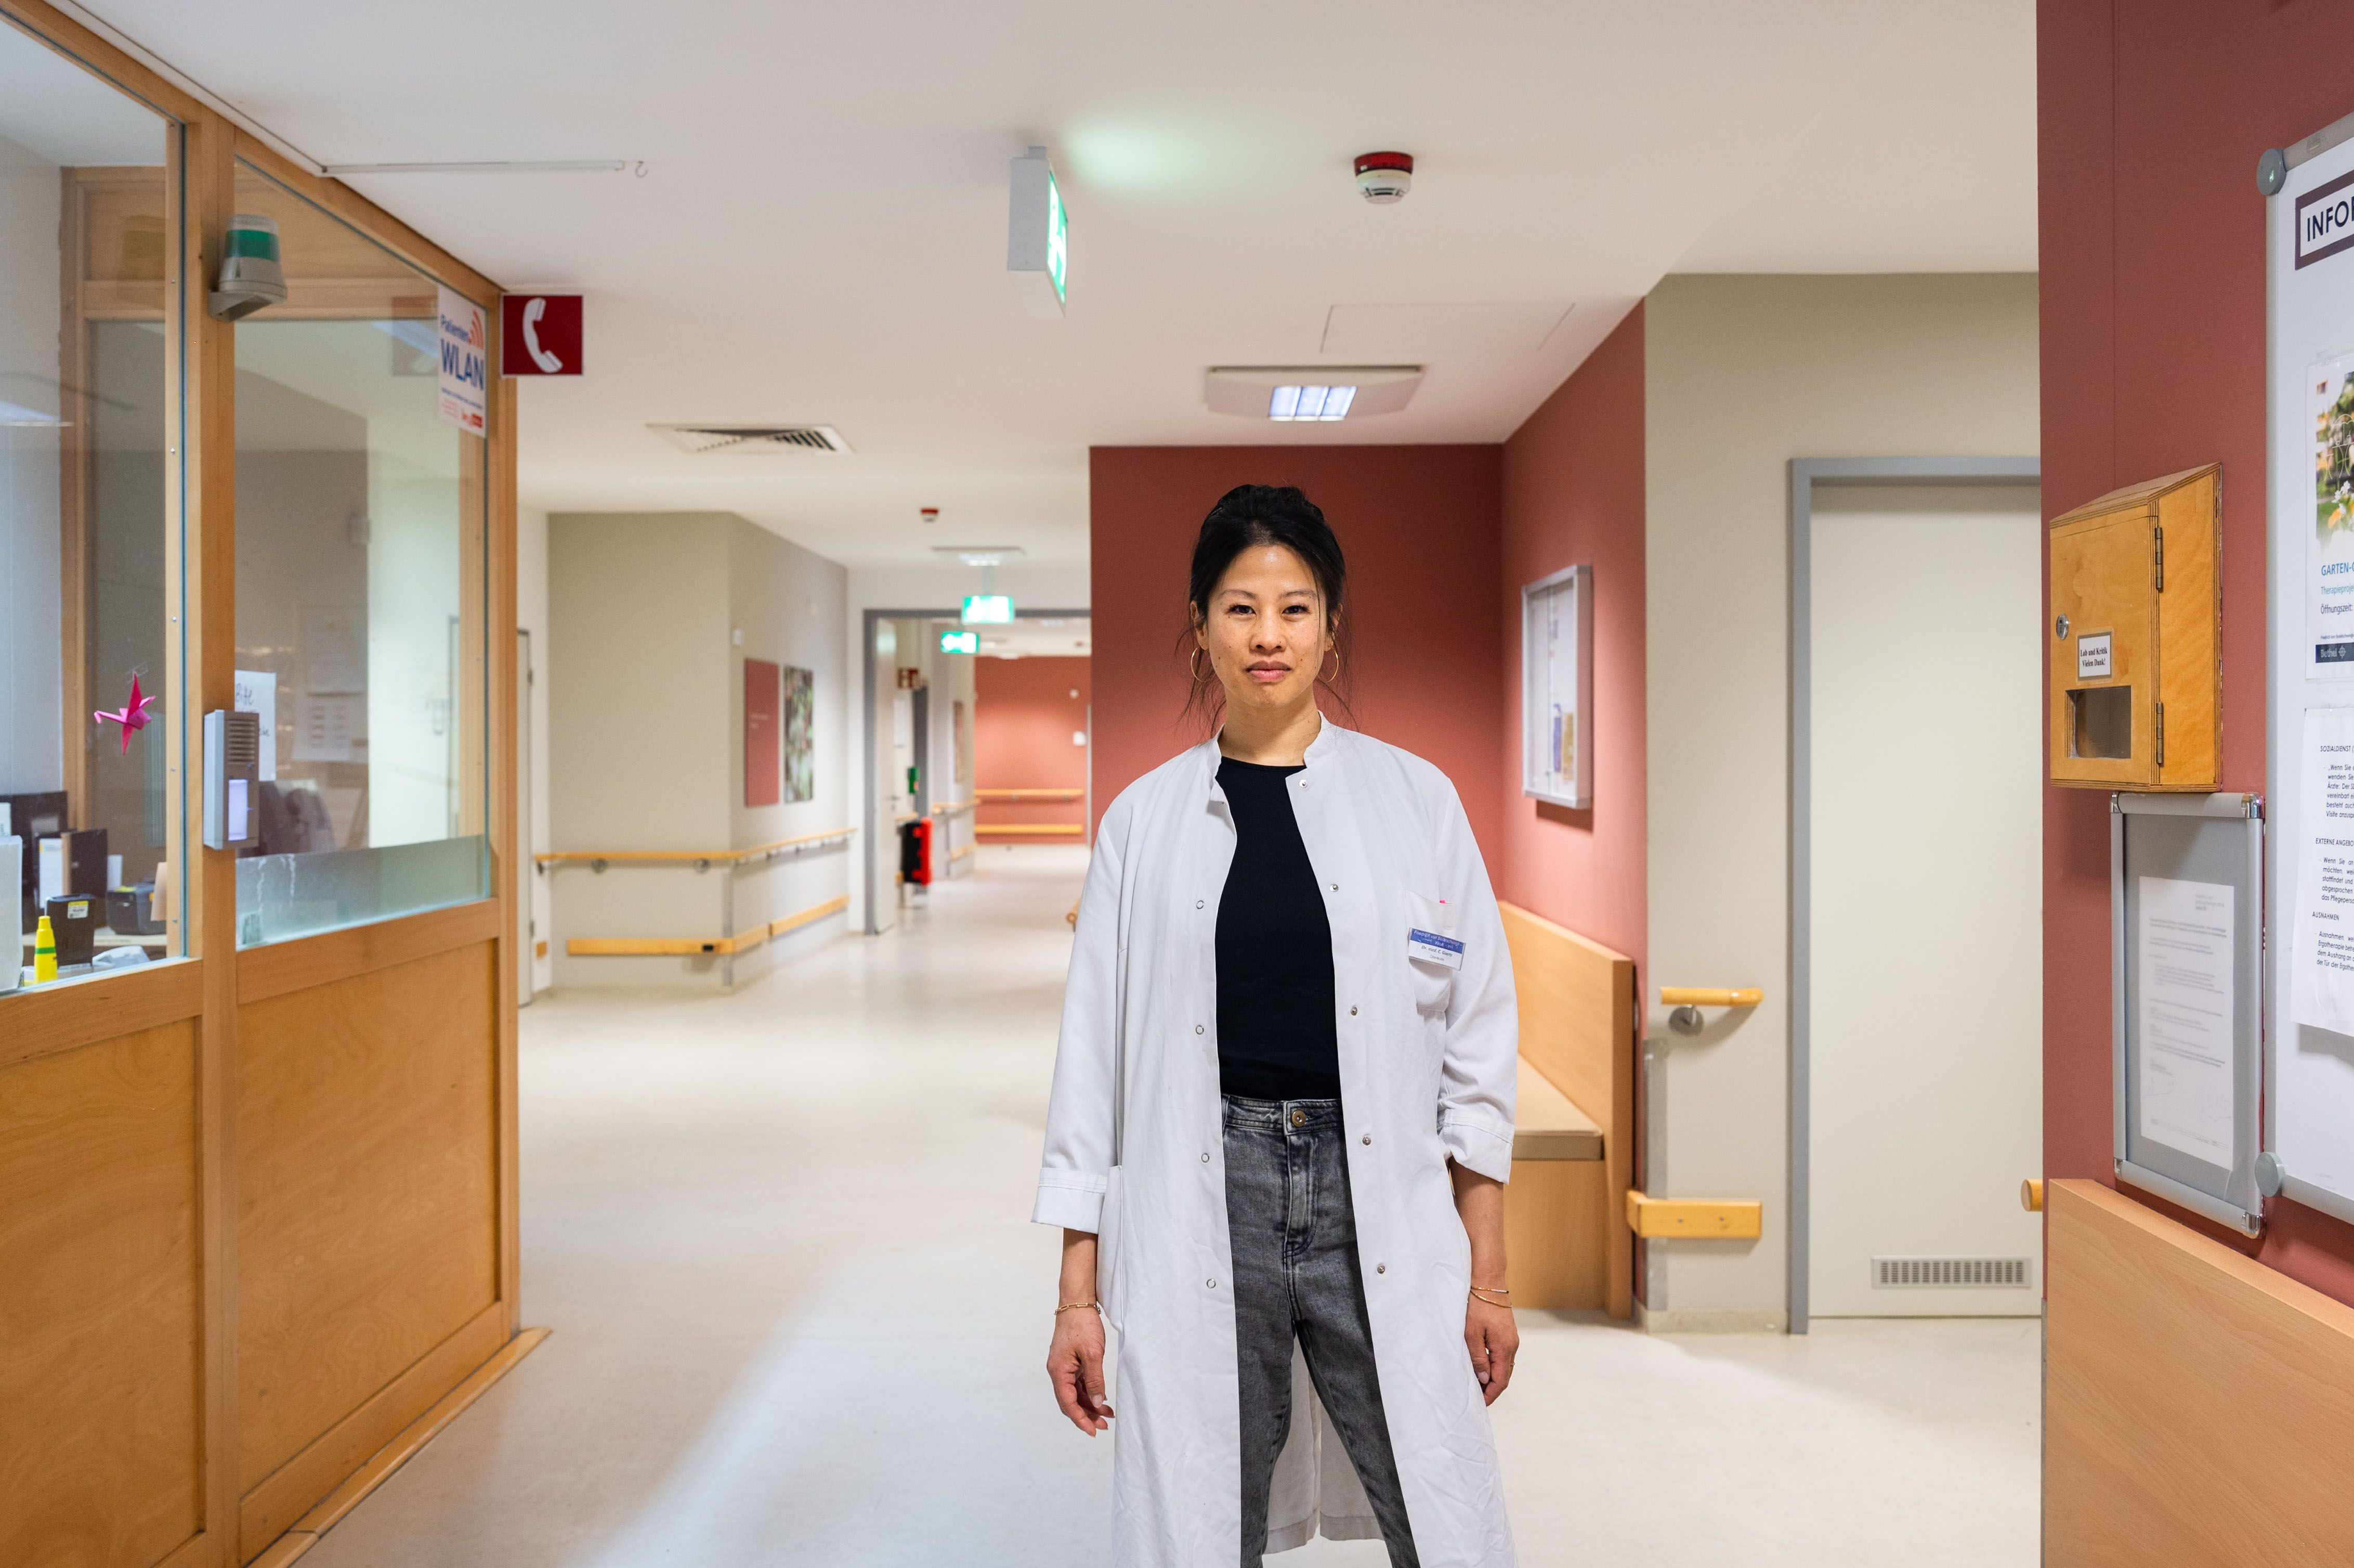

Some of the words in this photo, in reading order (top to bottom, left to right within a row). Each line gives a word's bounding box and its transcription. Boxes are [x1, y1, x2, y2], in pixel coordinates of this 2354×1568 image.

[441, 338, 483, 390] WLAN
[2320, 583, 2354, 595] Therapieproje
[2320, 603, 2353, 615] Öffnungszeit:
[2096, 647, 2108, 655] Kritik
[2320, 648, 2337, 658] Bethel
[2094, 658, 2105, 666] Dank!
[2322, 885, 2352, 894] abgesprochen
[2312, 911, 2339, 921] AUSNAHMEN
[2318, 940, 2344, 950] Ergotherapie
[2327, 951, 2346, 961] Aushang
